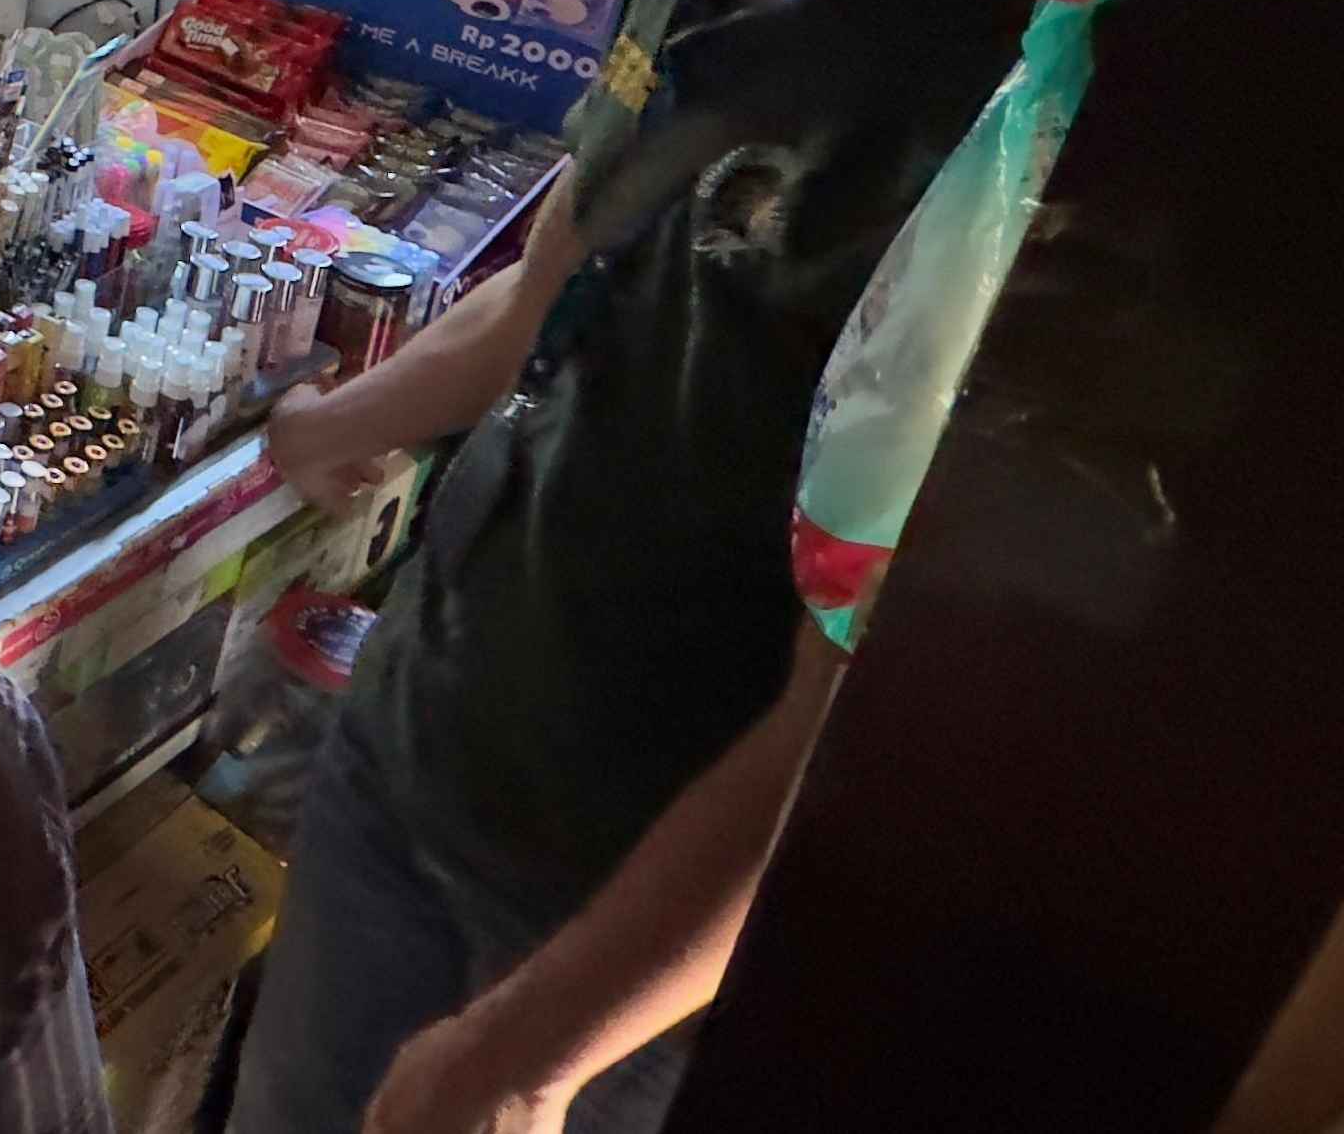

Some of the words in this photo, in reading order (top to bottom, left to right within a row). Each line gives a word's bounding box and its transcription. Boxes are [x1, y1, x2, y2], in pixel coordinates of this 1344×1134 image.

[181, 17, 229, 36] Good
[461, 24, 496, 51] Rp
[500, 33, 600, 79] 2000
